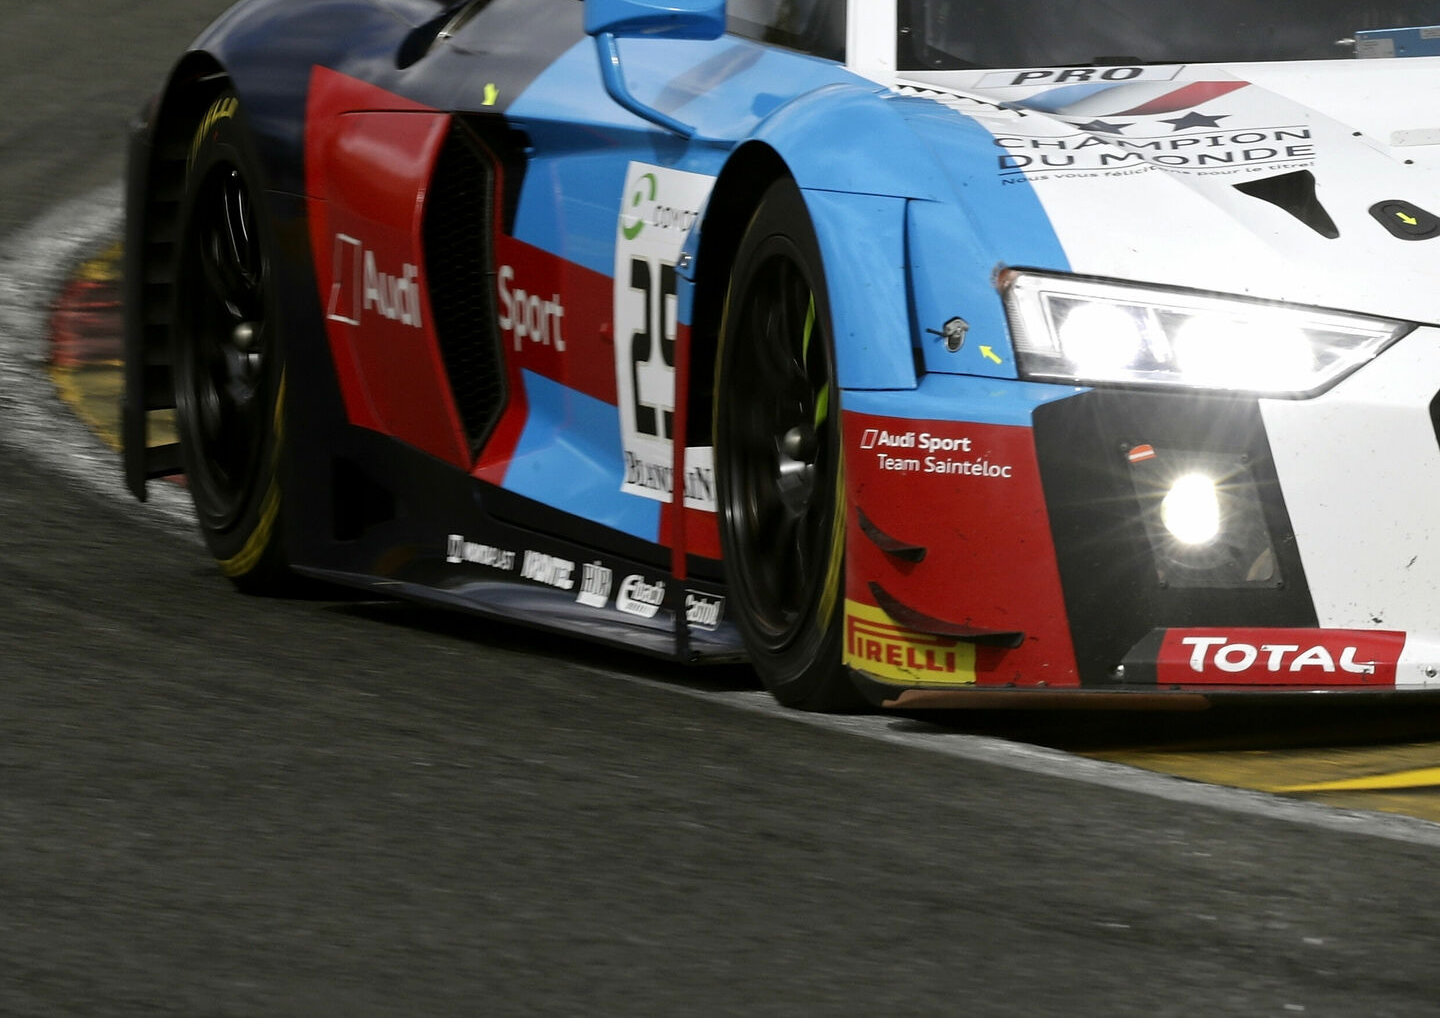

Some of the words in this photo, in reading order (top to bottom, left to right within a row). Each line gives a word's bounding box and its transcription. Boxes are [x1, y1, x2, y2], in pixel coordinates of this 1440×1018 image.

[1010, 67, 1144, 86] PRO
[992, 129, 1312, 150] CHAMPION
[998, 154, 1075, 170] DU
[1101, 144, 1316, 166] MONDE
[1001, 174, 1049, 186] Nous
[1055, 171, 1098, 179] vous
[1196, 169, 1241, 177] pour
[363, 249, 423, 329] Audi
[498, 264, 567, 353] Sport
[878, 430, 916, 448] Audi
[918, 432, 972, 453] Sport
[877, 453, 921, 472] Team
[924, 456, 1012, 479] Saintéloc
[847, 614, 956, 674] PIRELLI
[1182, 636, 1376, 675] TOTAL
